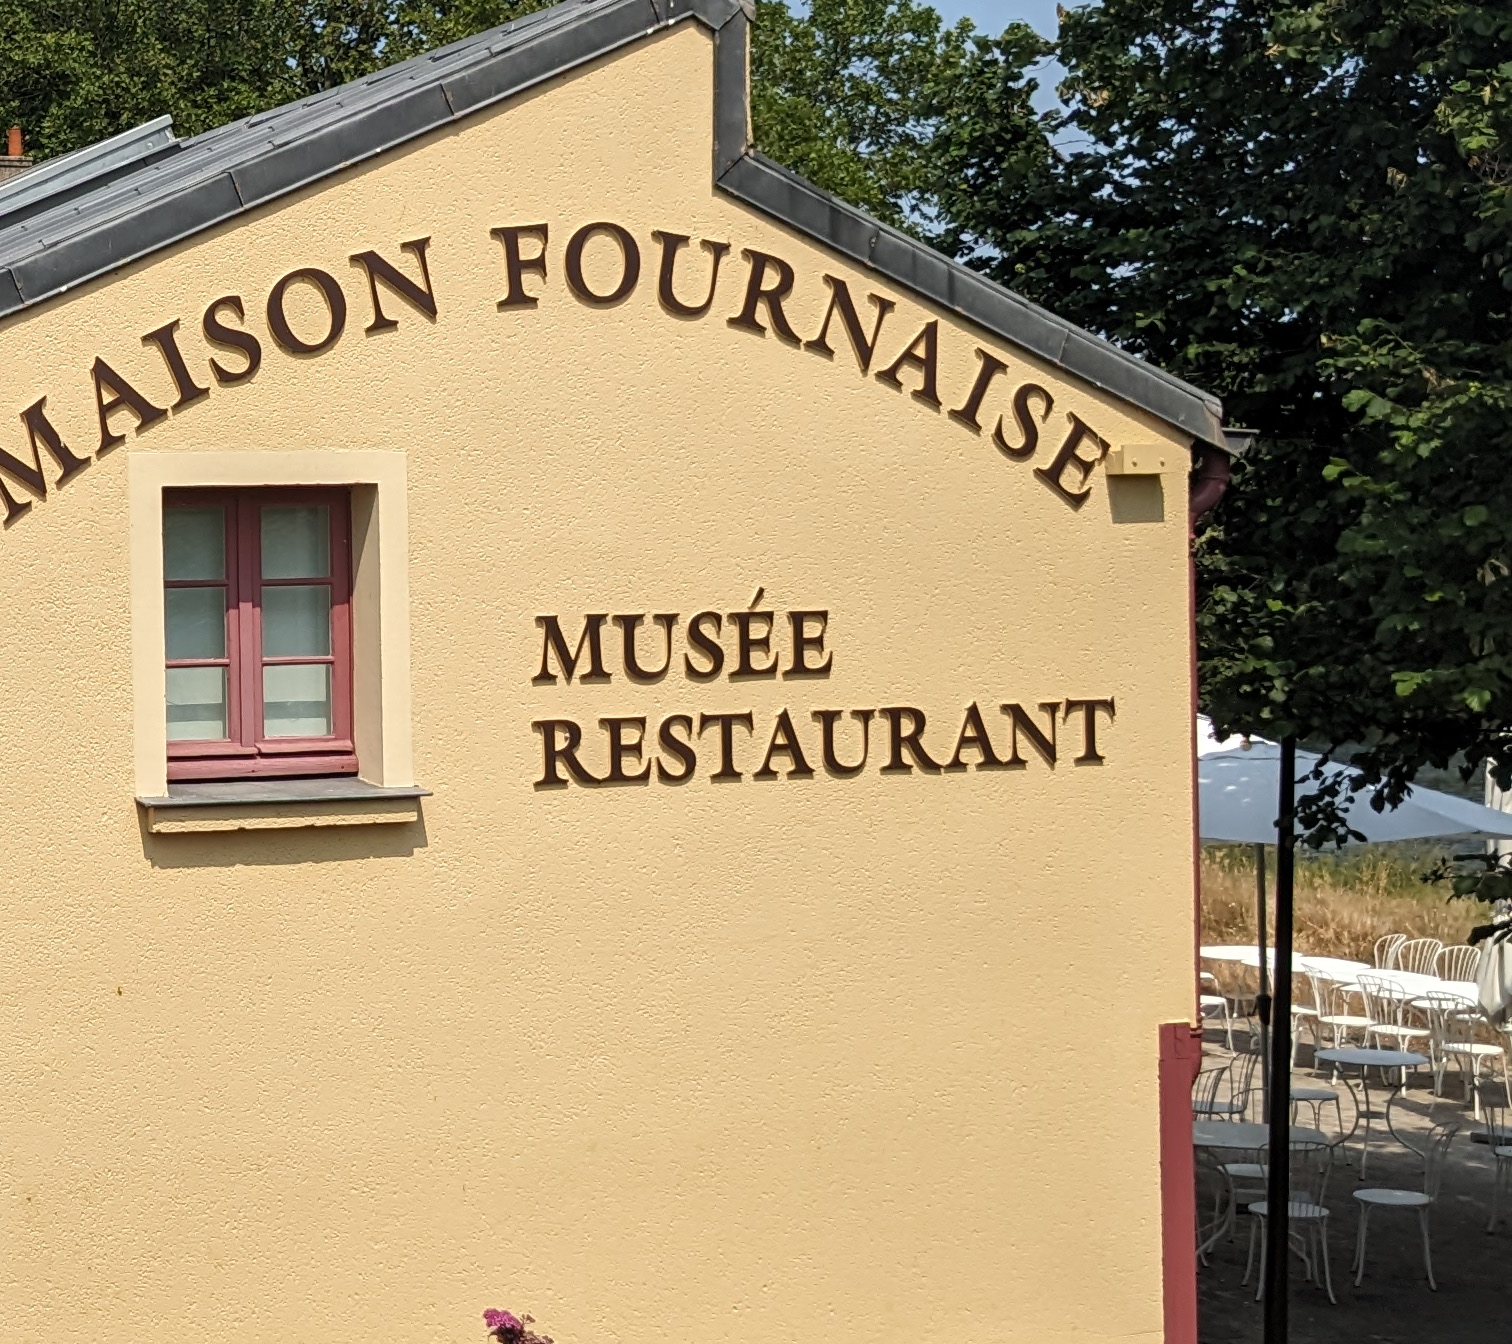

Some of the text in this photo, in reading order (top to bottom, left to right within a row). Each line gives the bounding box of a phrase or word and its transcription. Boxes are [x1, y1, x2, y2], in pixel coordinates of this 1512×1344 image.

[489, 221, 1111, 511] FOURNAISE
[532, 586, 834, 686] MUSÉE
[531, 695, 1116, 792] RESTAURANT
